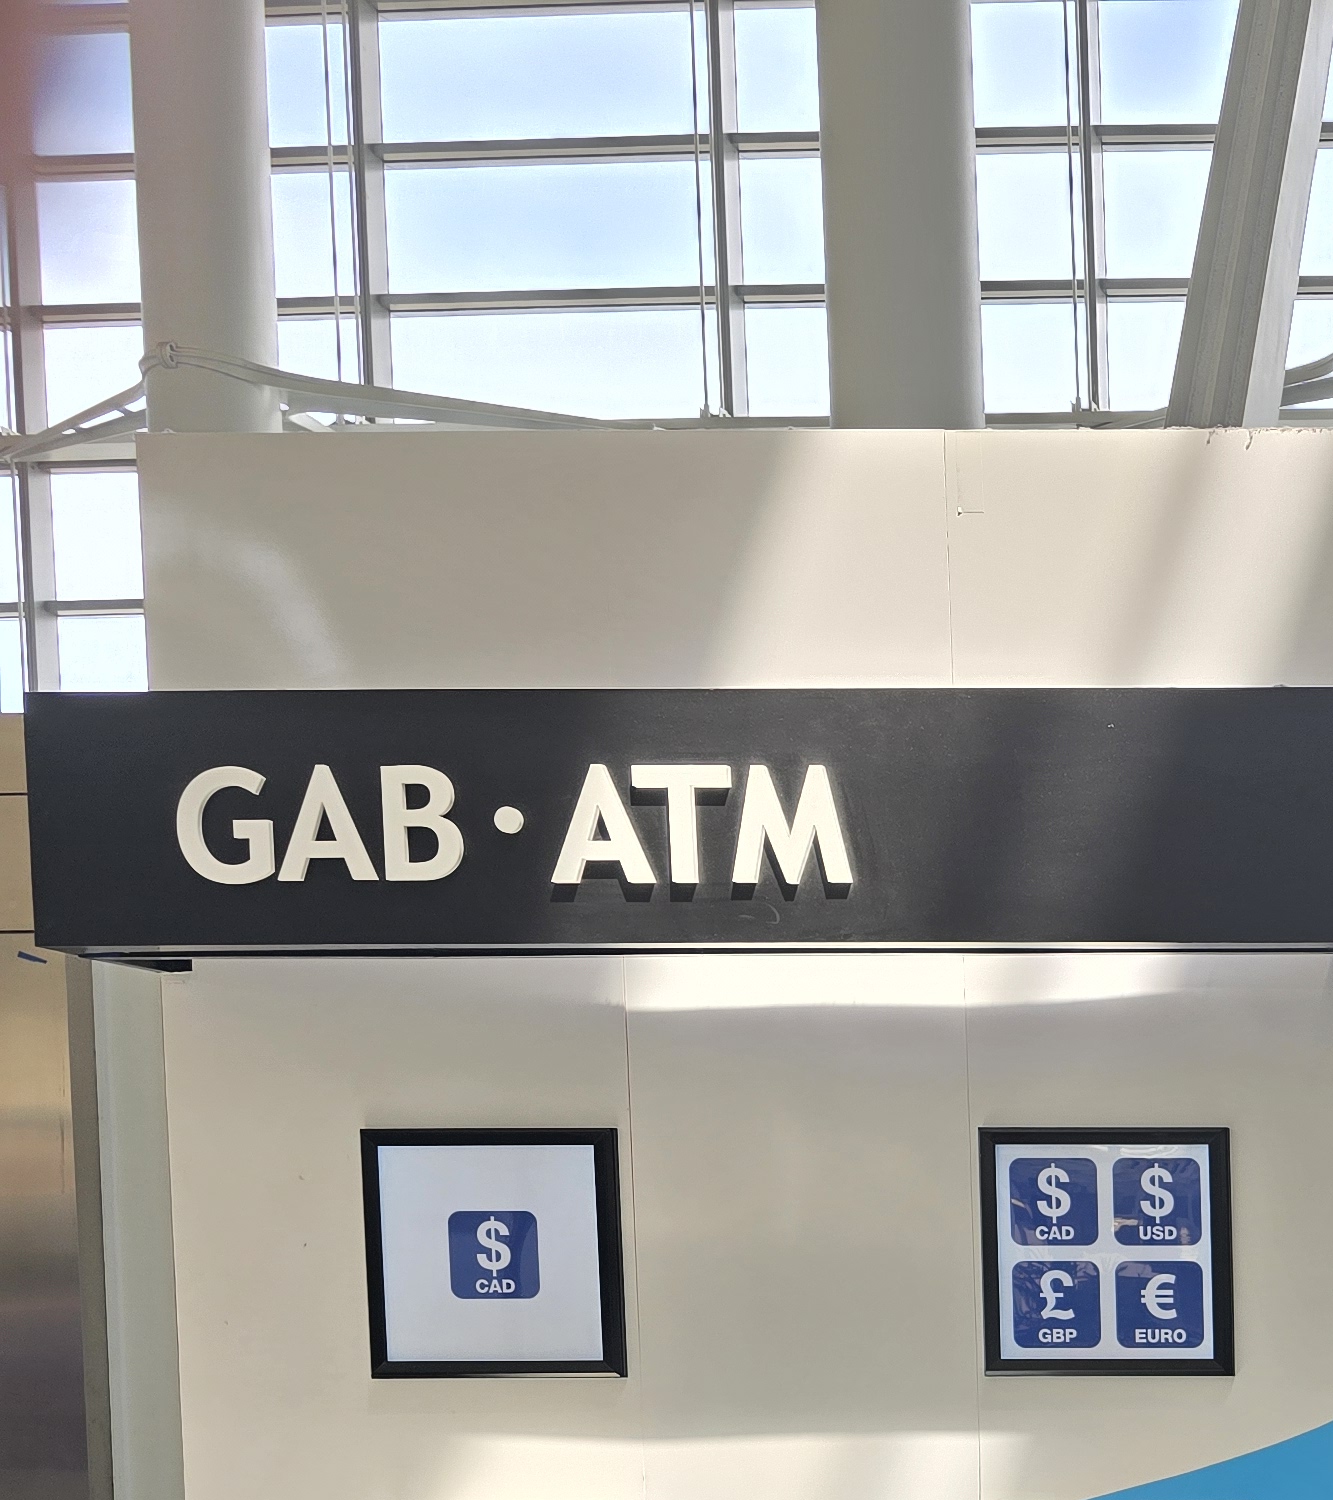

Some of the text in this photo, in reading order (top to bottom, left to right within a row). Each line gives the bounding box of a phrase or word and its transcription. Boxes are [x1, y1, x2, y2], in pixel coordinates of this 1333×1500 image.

[175, 763, 465, 886] GAB
[550, 763, 854, 886] ATM
[1036, 1162, 1071, 1224] $
[1140, 1162, 1175, 1224] $
[476, 1215, 512, 1277] $
[1035, 1225, 1075, 1241] CAD
[1138, 1225, 1178, 1241] USD
[475, 1278, 516, 1295] CAD
[1039, 1269, 1076, 1321] £
[1140, 1273, 1178, 1320] €
[1038, 1328, 1078, 1344] GBP
[1134, 1328, 1188, 1344] EURO
